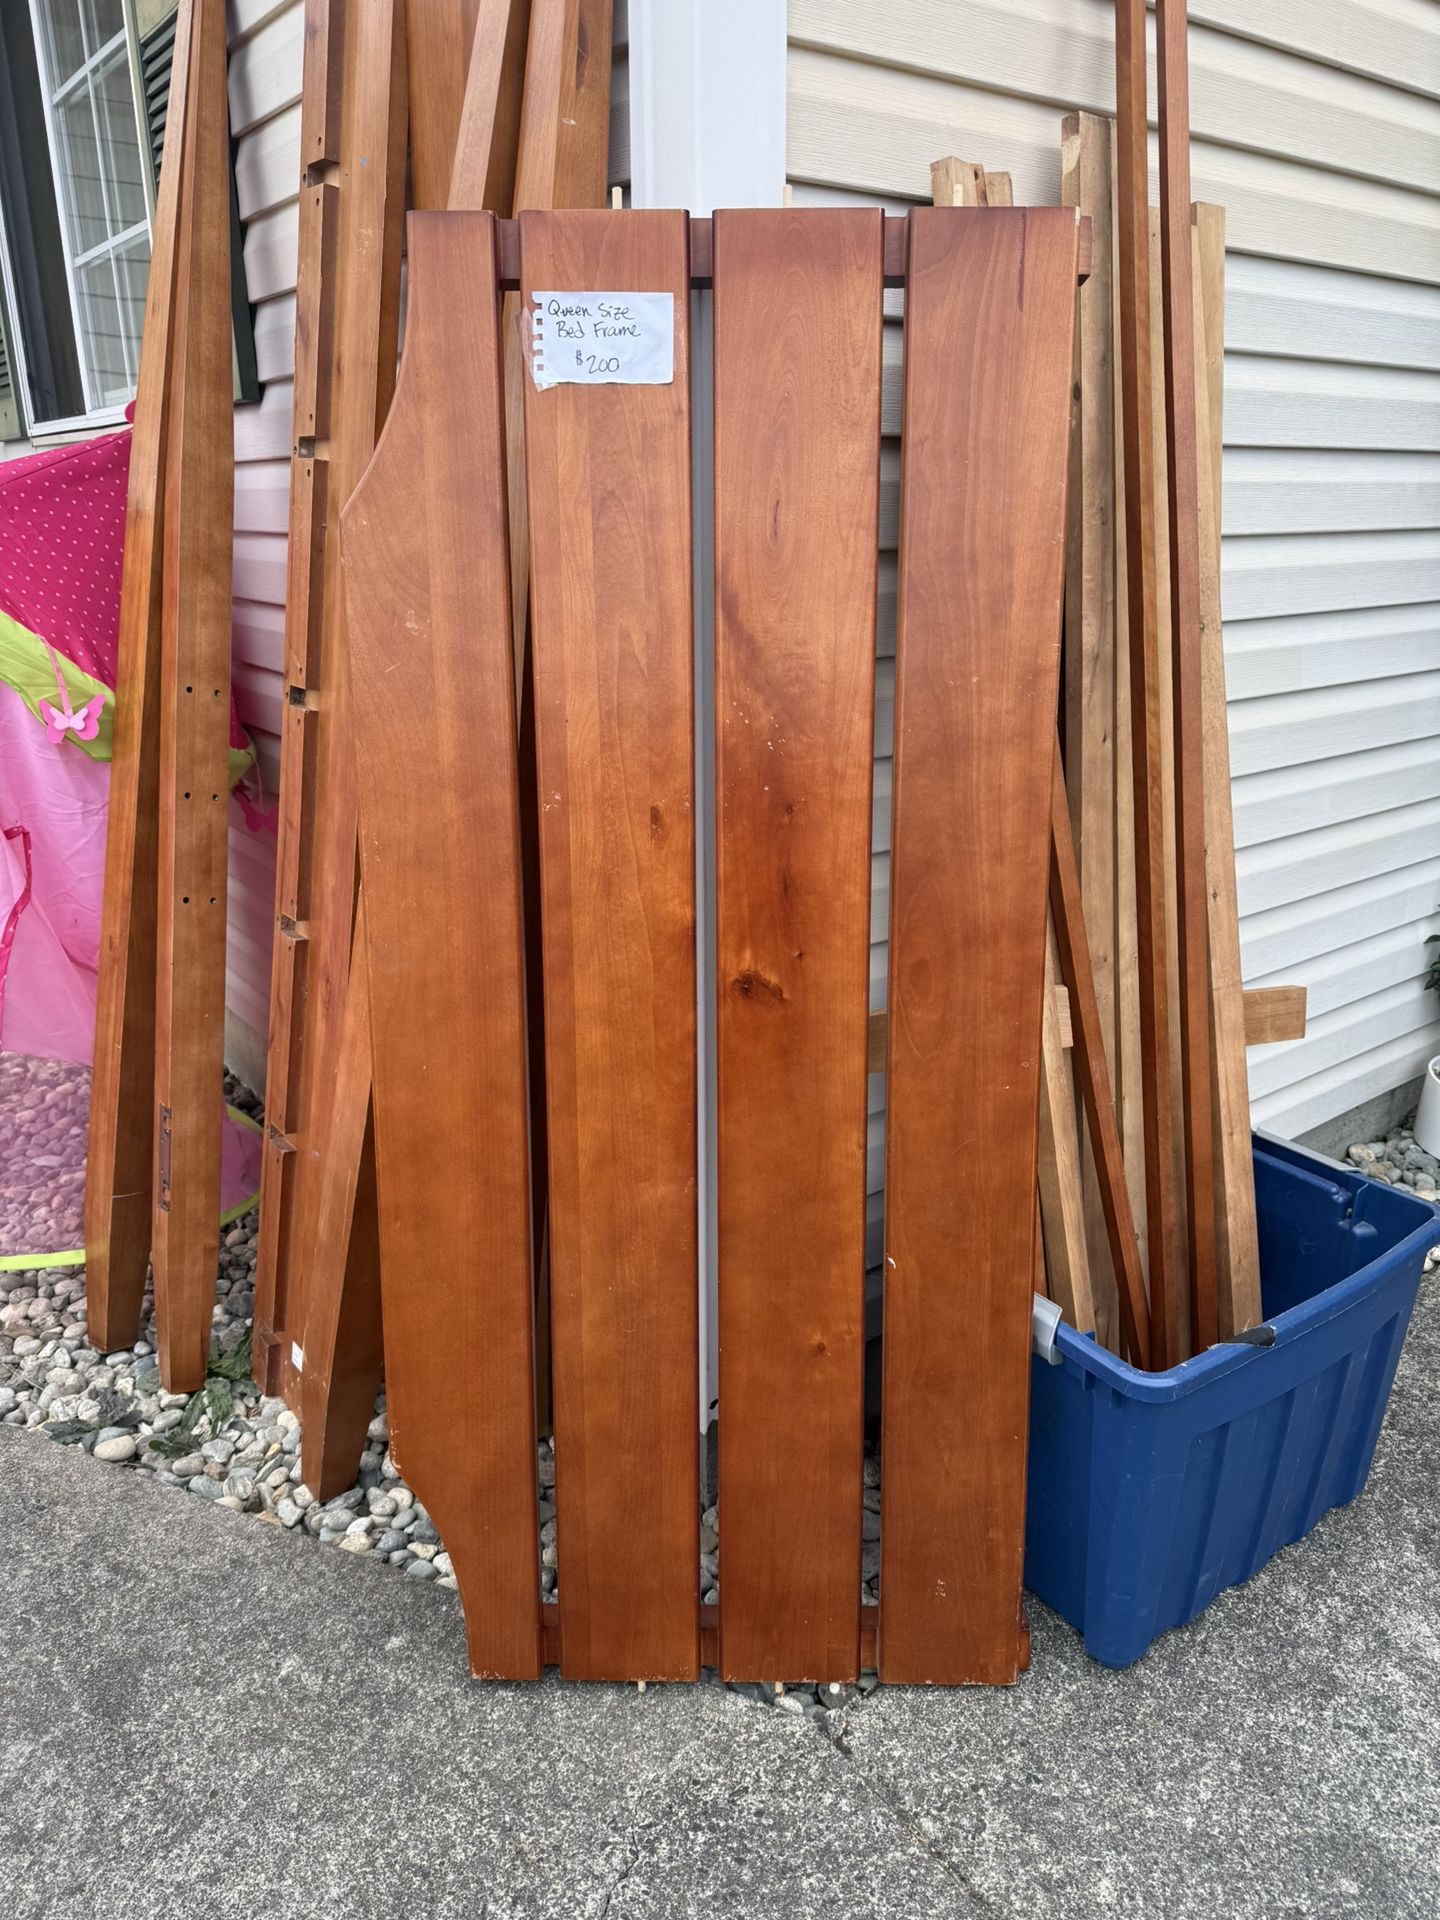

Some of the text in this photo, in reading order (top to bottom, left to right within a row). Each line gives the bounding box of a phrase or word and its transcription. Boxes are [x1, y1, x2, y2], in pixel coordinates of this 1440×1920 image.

[548, 299, 635, 320] Queen Size
[556, 320, 641, 339] Bed Frame
[576, 350, 620, 374] $200
